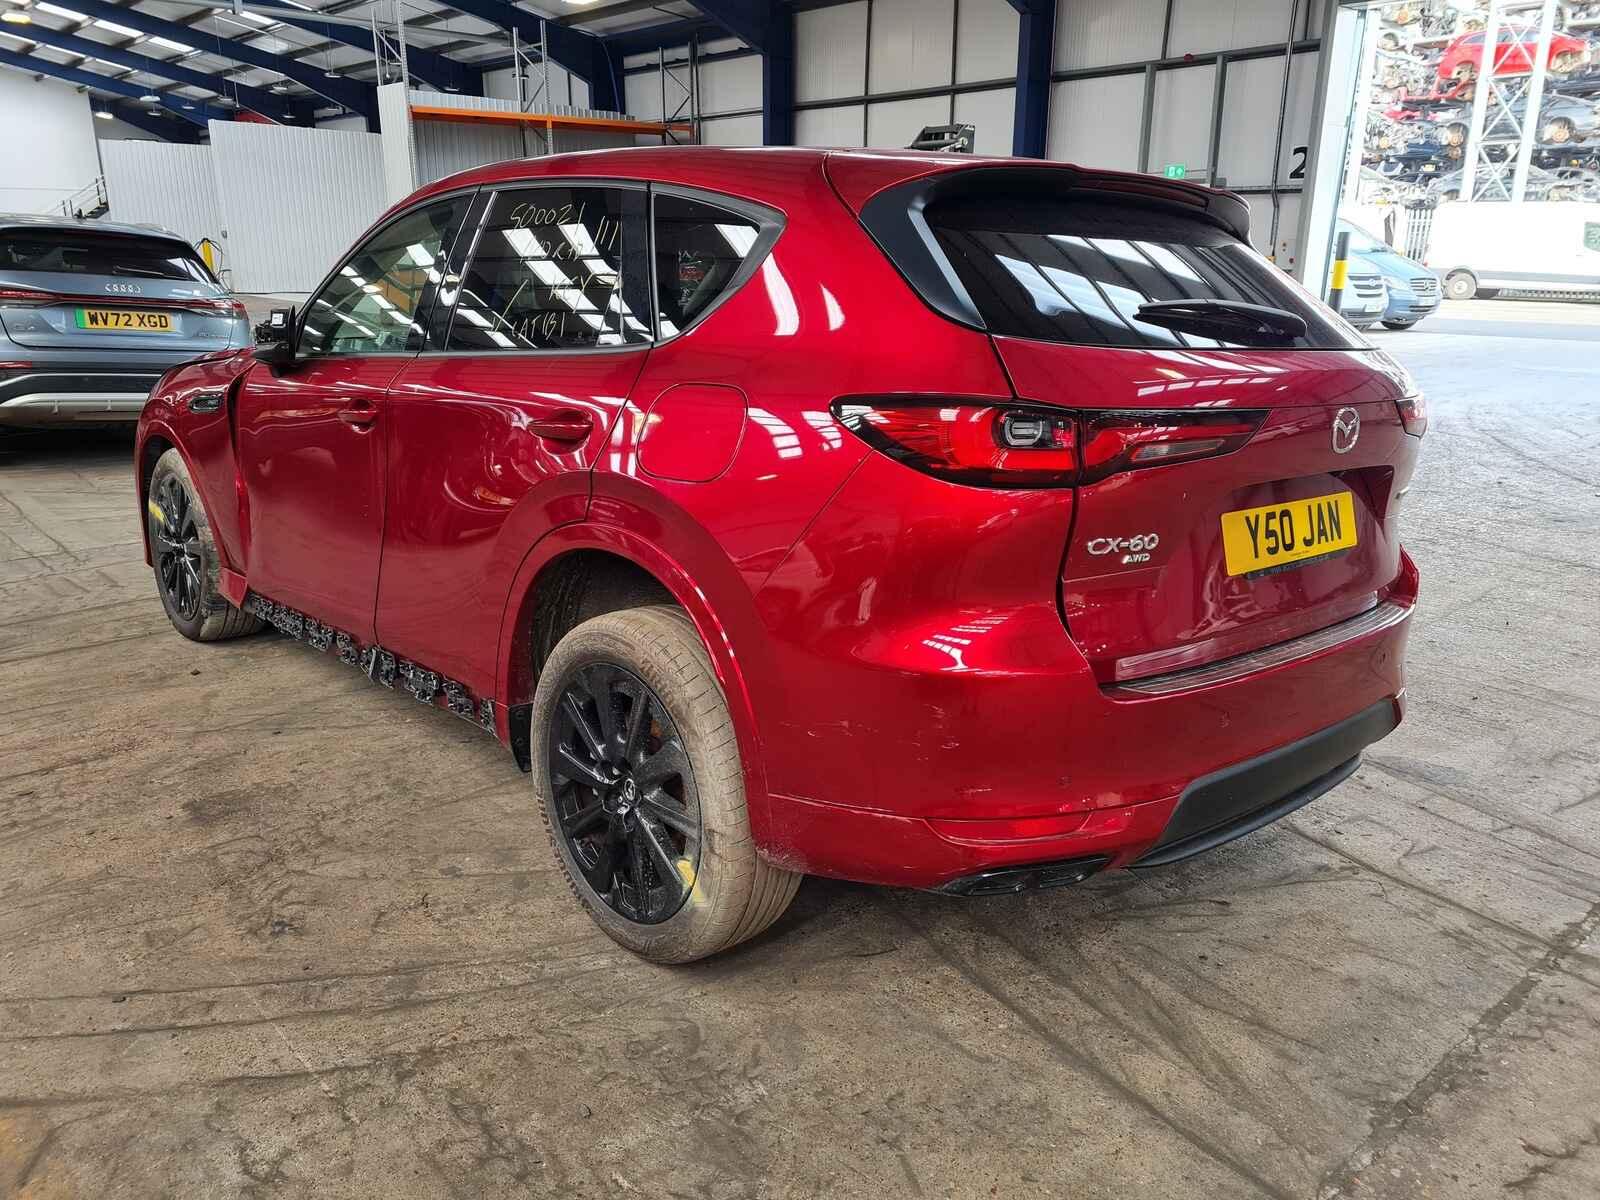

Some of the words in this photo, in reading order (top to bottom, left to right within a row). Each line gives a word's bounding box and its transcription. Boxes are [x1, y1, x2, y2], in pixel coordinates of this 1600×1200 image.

[1289, 146, 1308, 179] 2
[87, 312, 133, 327] WV72
[138, 314, 168, 328] XGD
[1244, 508, 1295, 559] Y50
[1302, 499, 1342, 547] JAN
[1087, 533, 1160, 555] CX-60
[1121, 553, 1151, 564] AWD
